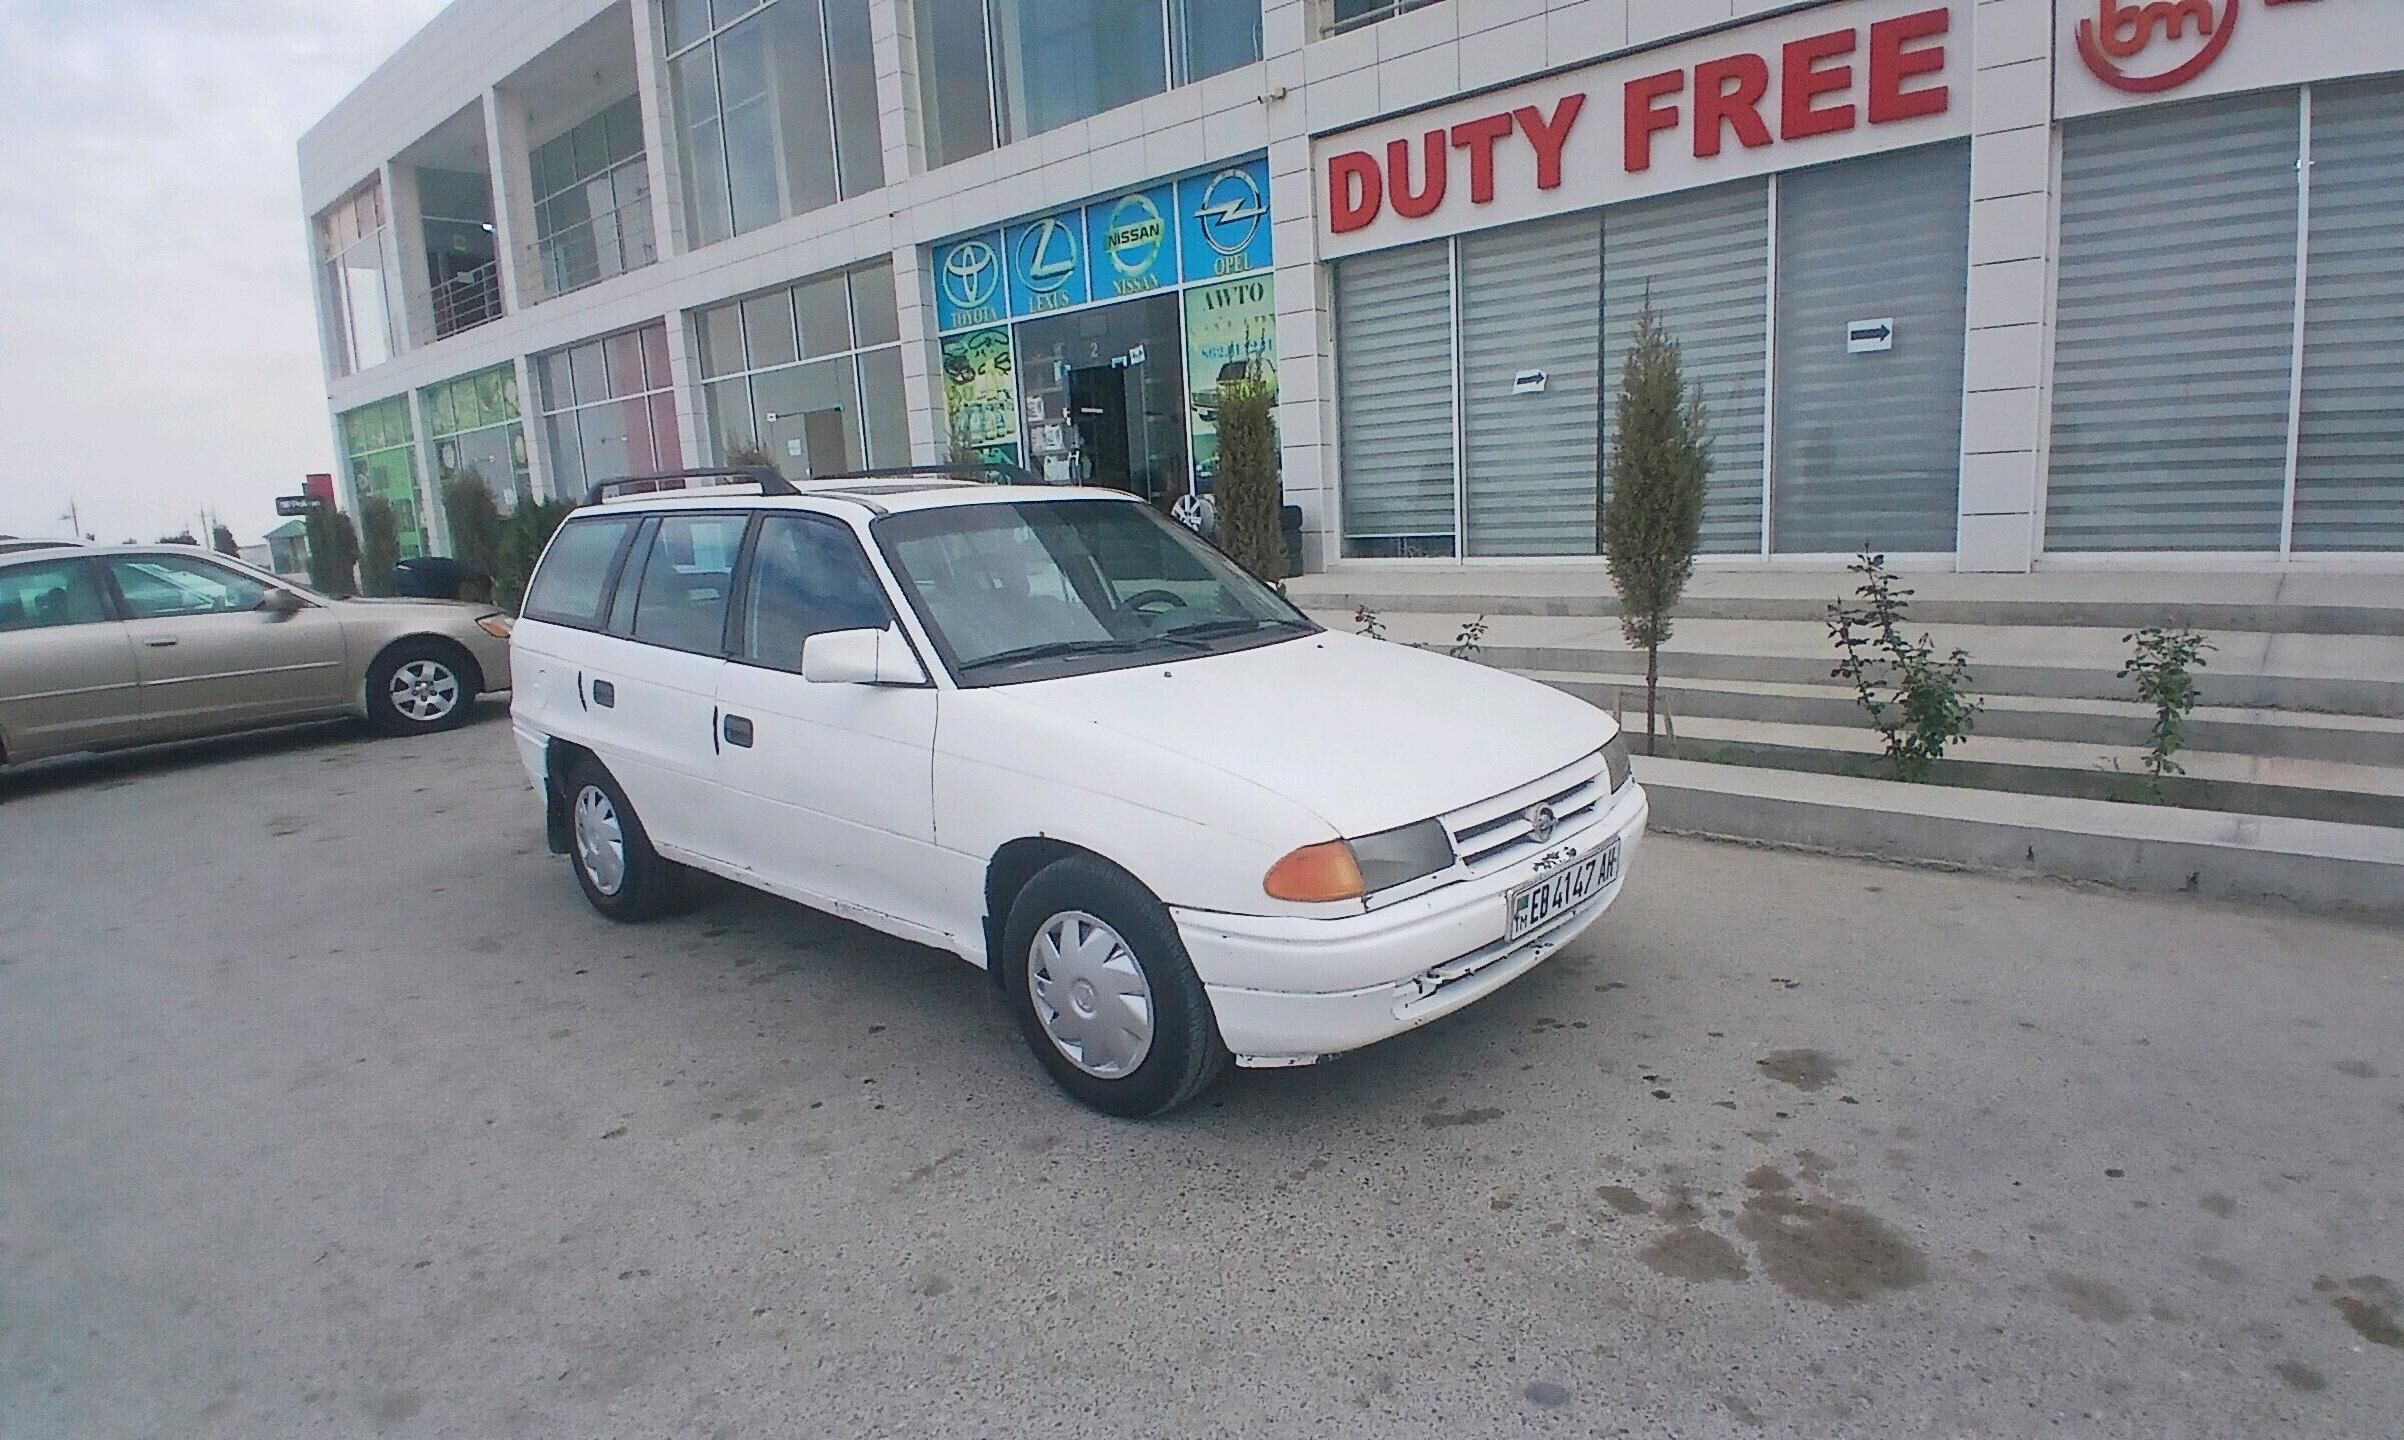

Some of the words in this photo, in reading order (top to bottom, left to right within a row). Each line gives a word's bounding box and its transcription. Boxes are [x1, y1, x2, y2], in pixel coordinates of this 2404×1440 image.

[1329, 93, 1586, 234] DUTY
[1624, 8, 1949, 172] FREE
[1108, 222, 1161, 247] NISSAN
[1214, 252, 1253, 276] OPEL
[1202, 282, 1264, 311] AWTO
[951, 305, 998, 328] TOYOTA
